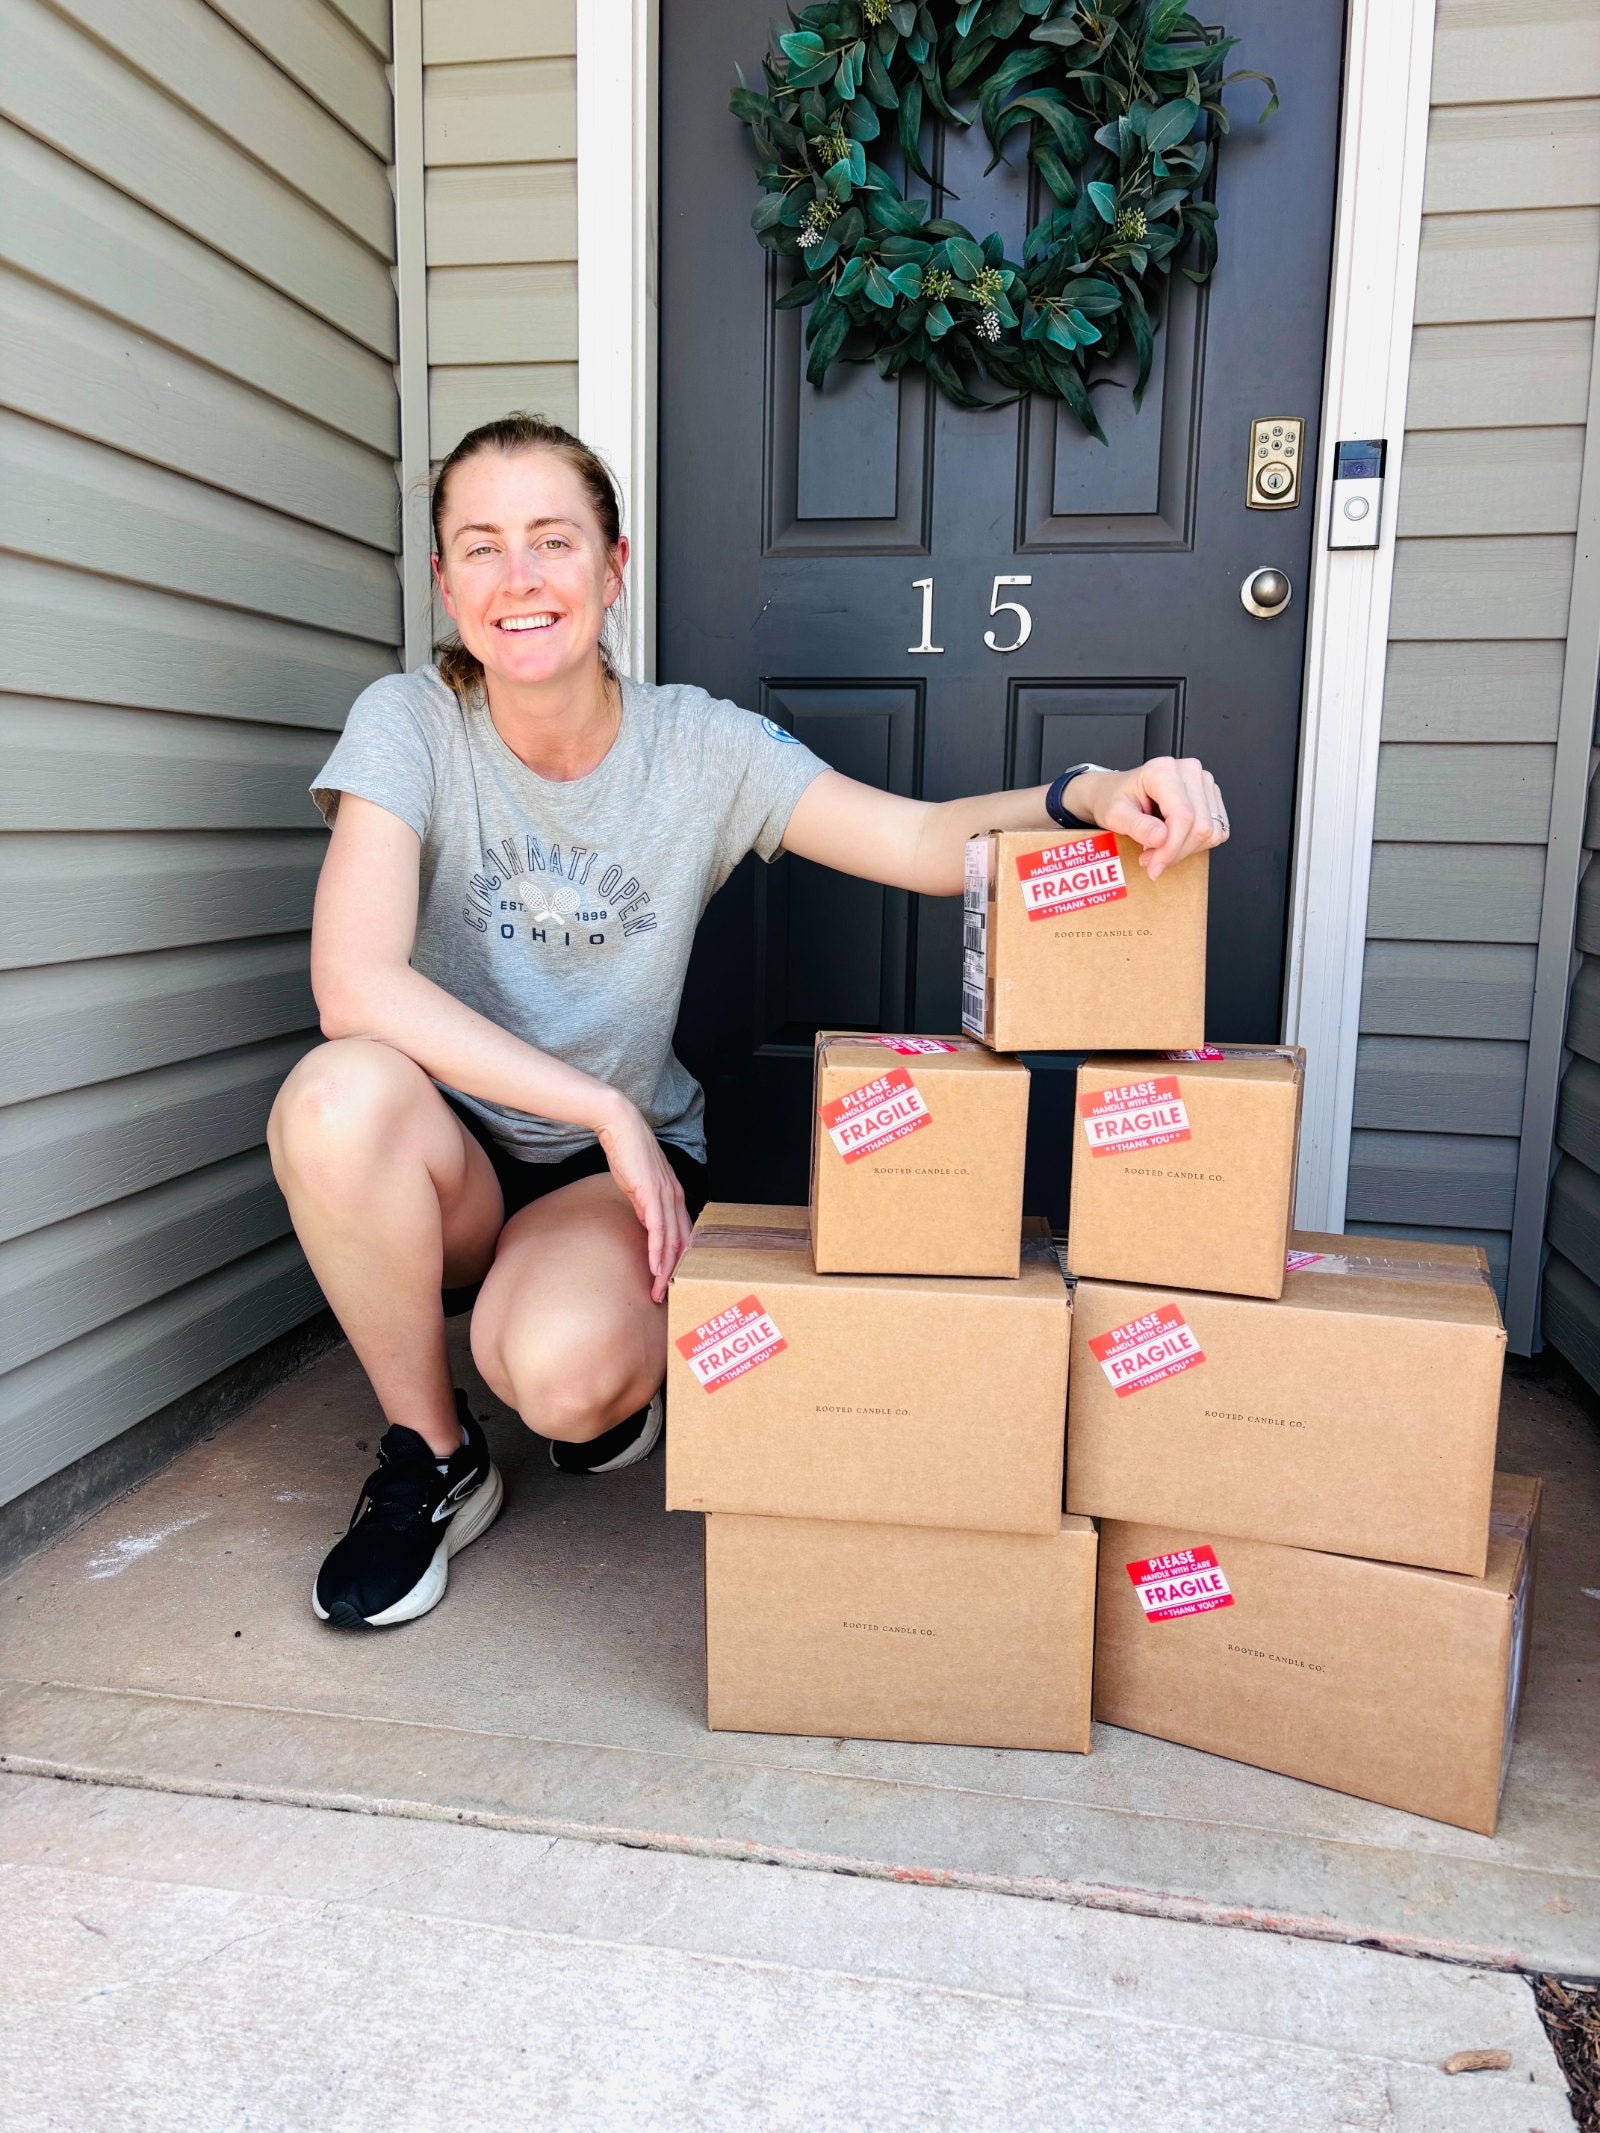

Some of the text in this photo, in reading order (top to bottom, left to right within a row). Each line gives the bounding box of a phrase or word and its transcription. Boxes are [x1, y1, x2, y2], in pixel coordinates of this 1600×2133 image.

[907, 575, 1033, 654] 15
[1030, 849, 1111, 877] HANDLE WITH CARE
[1041, 839, 1094, 864] PLEASE
[463, 835, 657, 937] CINCINNATI OPEN
[1031, 864, 1119, 902] FRAGILE
[500, 900, 608, 921] EST. 1899
[500, 924, 605, 946] OHIO
[1054, 929, 1153, 939] ROOTED CANDLE CO.
[834, 1082, 908, 1124] HANDLE WITH CARE
[841, 1077, 891, 1109] PLEASE
[1092, 1092, 1174, 1115] HANDLE WITH CARE
[1103, 1081, 1157, 1104] PLEASE
[839, 1095, 920, 1146] FRAGILE
[1093, 1106, 1182, 1139] FRAGILE
[874, 1167, 912, 1175] ROOTED
[1124, 1167, 1225, 1182] ROOTED CANDLE CO.
[692, 1310, 759, 1355] HANDLE WITH CARE
[696, 1306, 743, 1340] PLEASE
[1111, 1312, 1161, 1344] PLEASE
[698, 1322, 774, 1375] FRAGILE
[1105, 1319, 1178, 1357] HANDLE WITH CARE
[1111, 1332, 1193, 1379] FRAGILE
[815, 1405, 911, 1416] ROOTED CANDLE CO.
[1205, 1410, 1306, 1429] ROOTED CANDLE CO.
[1141, 1560, 1212, 1582] HANDLE WITH CARE
[1148, 1550, 1196, 1572] PLEASE
[1144, 1574, 1223, 1605] FRAGILE
[843, 1621, 936, 1636] ROOTED CANDLE CO.
[1227, 1644, 1326, 1673] ROOTED CANDLE CO.
